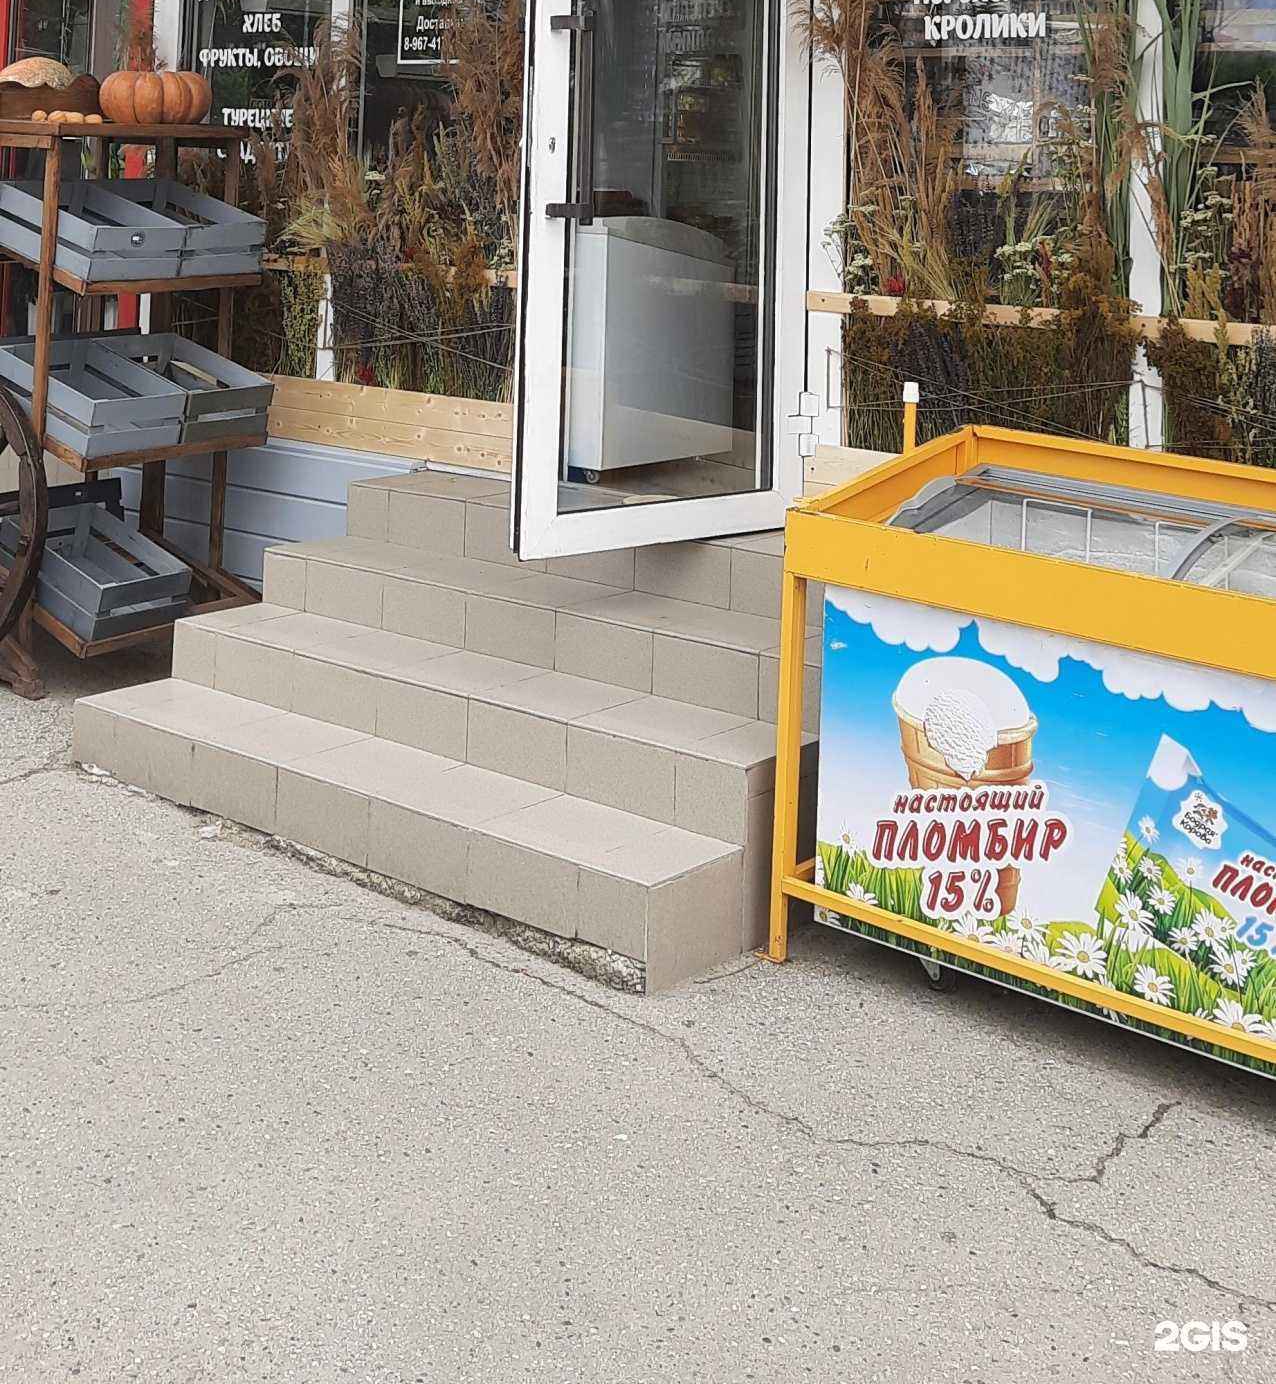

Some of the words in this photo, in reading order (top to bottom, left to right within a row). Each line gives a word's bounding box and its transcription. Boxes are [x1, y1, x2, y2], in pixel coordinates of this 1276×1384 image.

[242, 13, 281, 34] ХЛЕБ
[924, 12, 1046, 40] КРОЛИКИ
[199, 47, 261, 68] ФРУКТЫ,
[893, 784, 1045, 814] настоящий
[872, 818, 1067, 863] ПЛОМБИР
[1240, 854, 1276, 880] нас
[926, 869, 994, 913] 15%
[1236, 916, 1276, 955] 15
